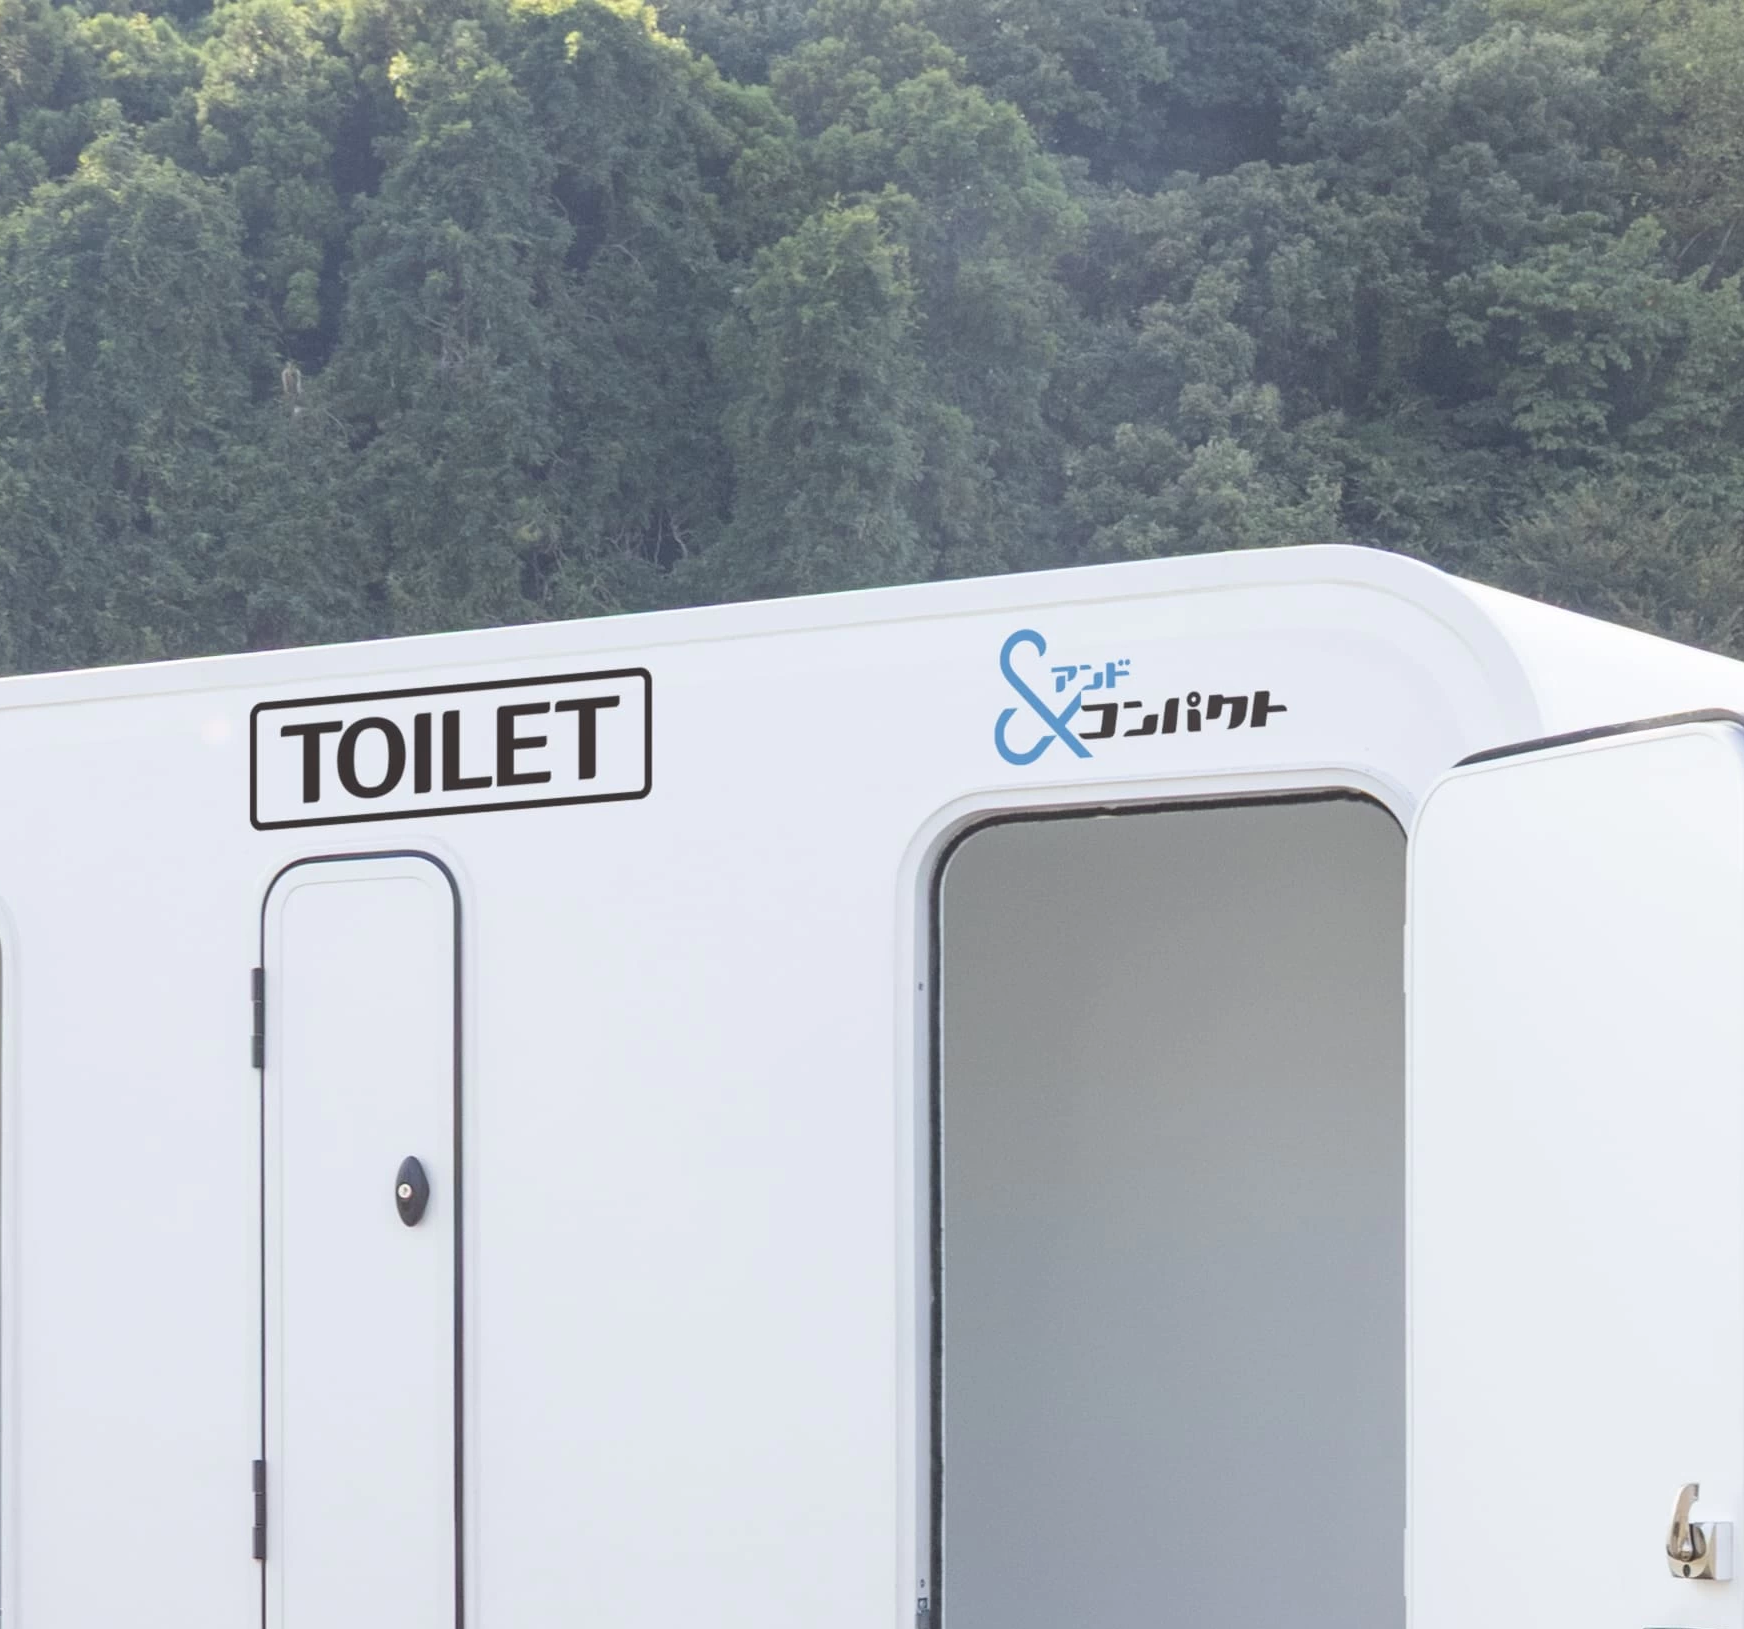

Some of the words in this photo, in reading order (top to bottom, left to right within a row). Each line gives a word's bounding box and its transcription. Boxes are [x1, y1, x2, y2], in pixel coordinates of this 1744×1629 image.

[993, 628, 1093, 766] &
[1050, 658, 1131, 693] アンド
[1078, 690, 1288, 740] コンパクト
[280, 695, 620, 804] TOILET
